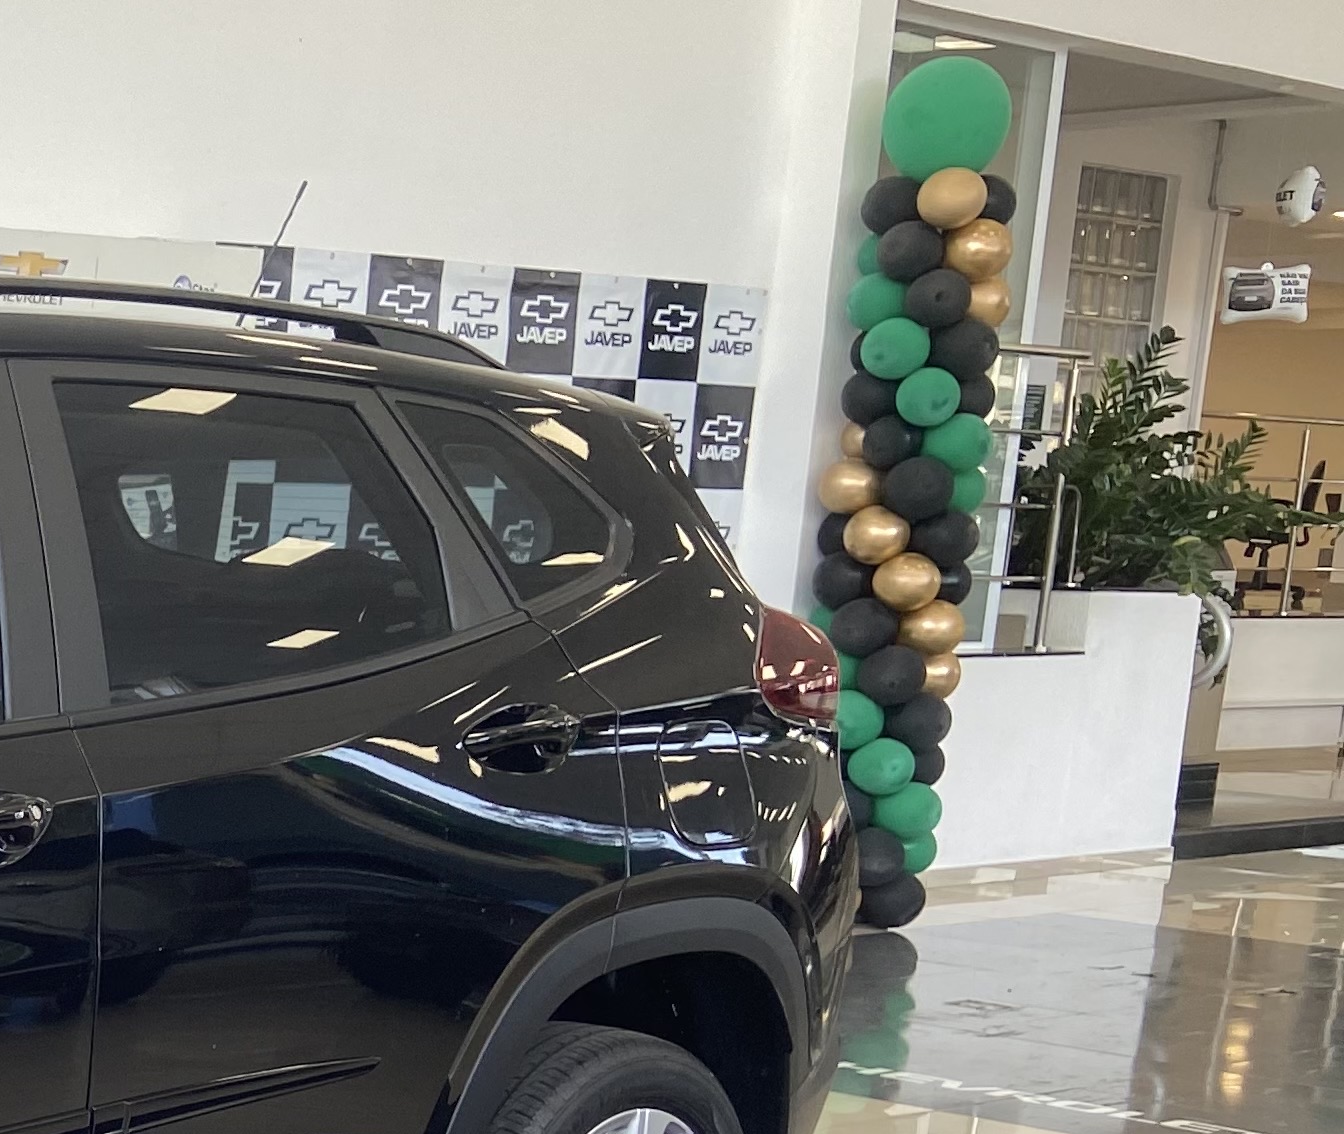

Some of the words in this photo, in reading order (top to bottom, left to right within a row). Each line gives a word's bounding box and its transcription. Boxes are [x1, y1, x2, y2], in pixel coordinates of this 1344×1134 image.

[515, 326, 567, 346] JAVEP
[584, 331, 632, 348] JAVEP
[647, 334, 695, 353] JAVEP
[708, 339, 753, 356] JAVEP
[696, 444, 741, 462] JAVEP
